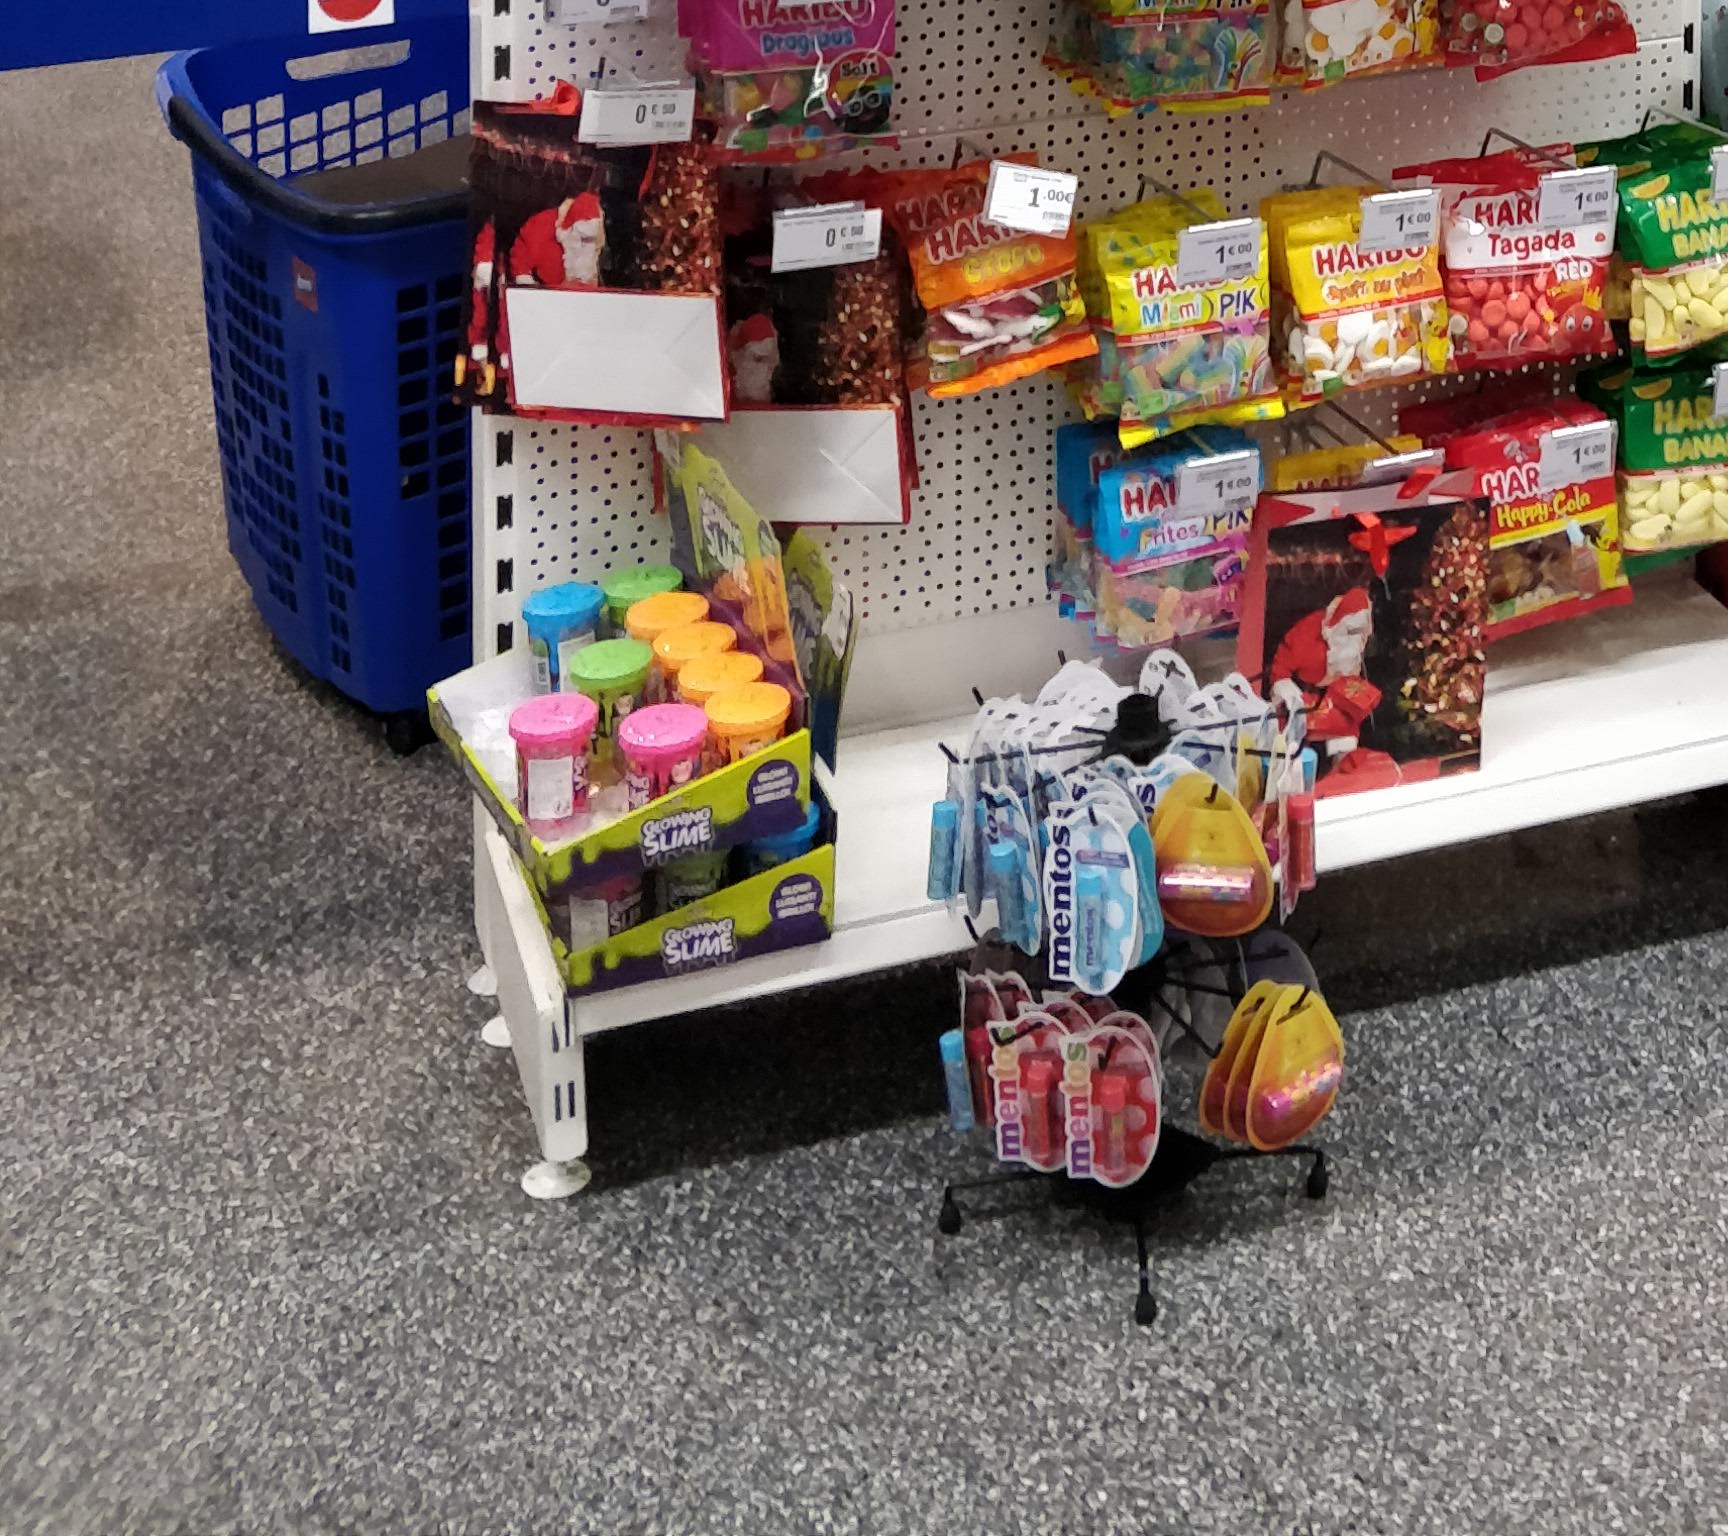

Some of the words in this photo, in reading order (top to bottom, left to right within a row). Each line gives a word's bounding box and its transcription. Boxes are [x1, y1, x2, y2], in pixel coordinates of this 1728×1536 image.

[1488, 229, 1576, 260] Tagada
[1555, 261, 1593, 282] RED
[1481, 462, 1542, 505] HAR
[643, 822, 712, 857] SLIME
[1050, 824, 1072, 978] mentos
[665, 934, 734, 965] SLIME
